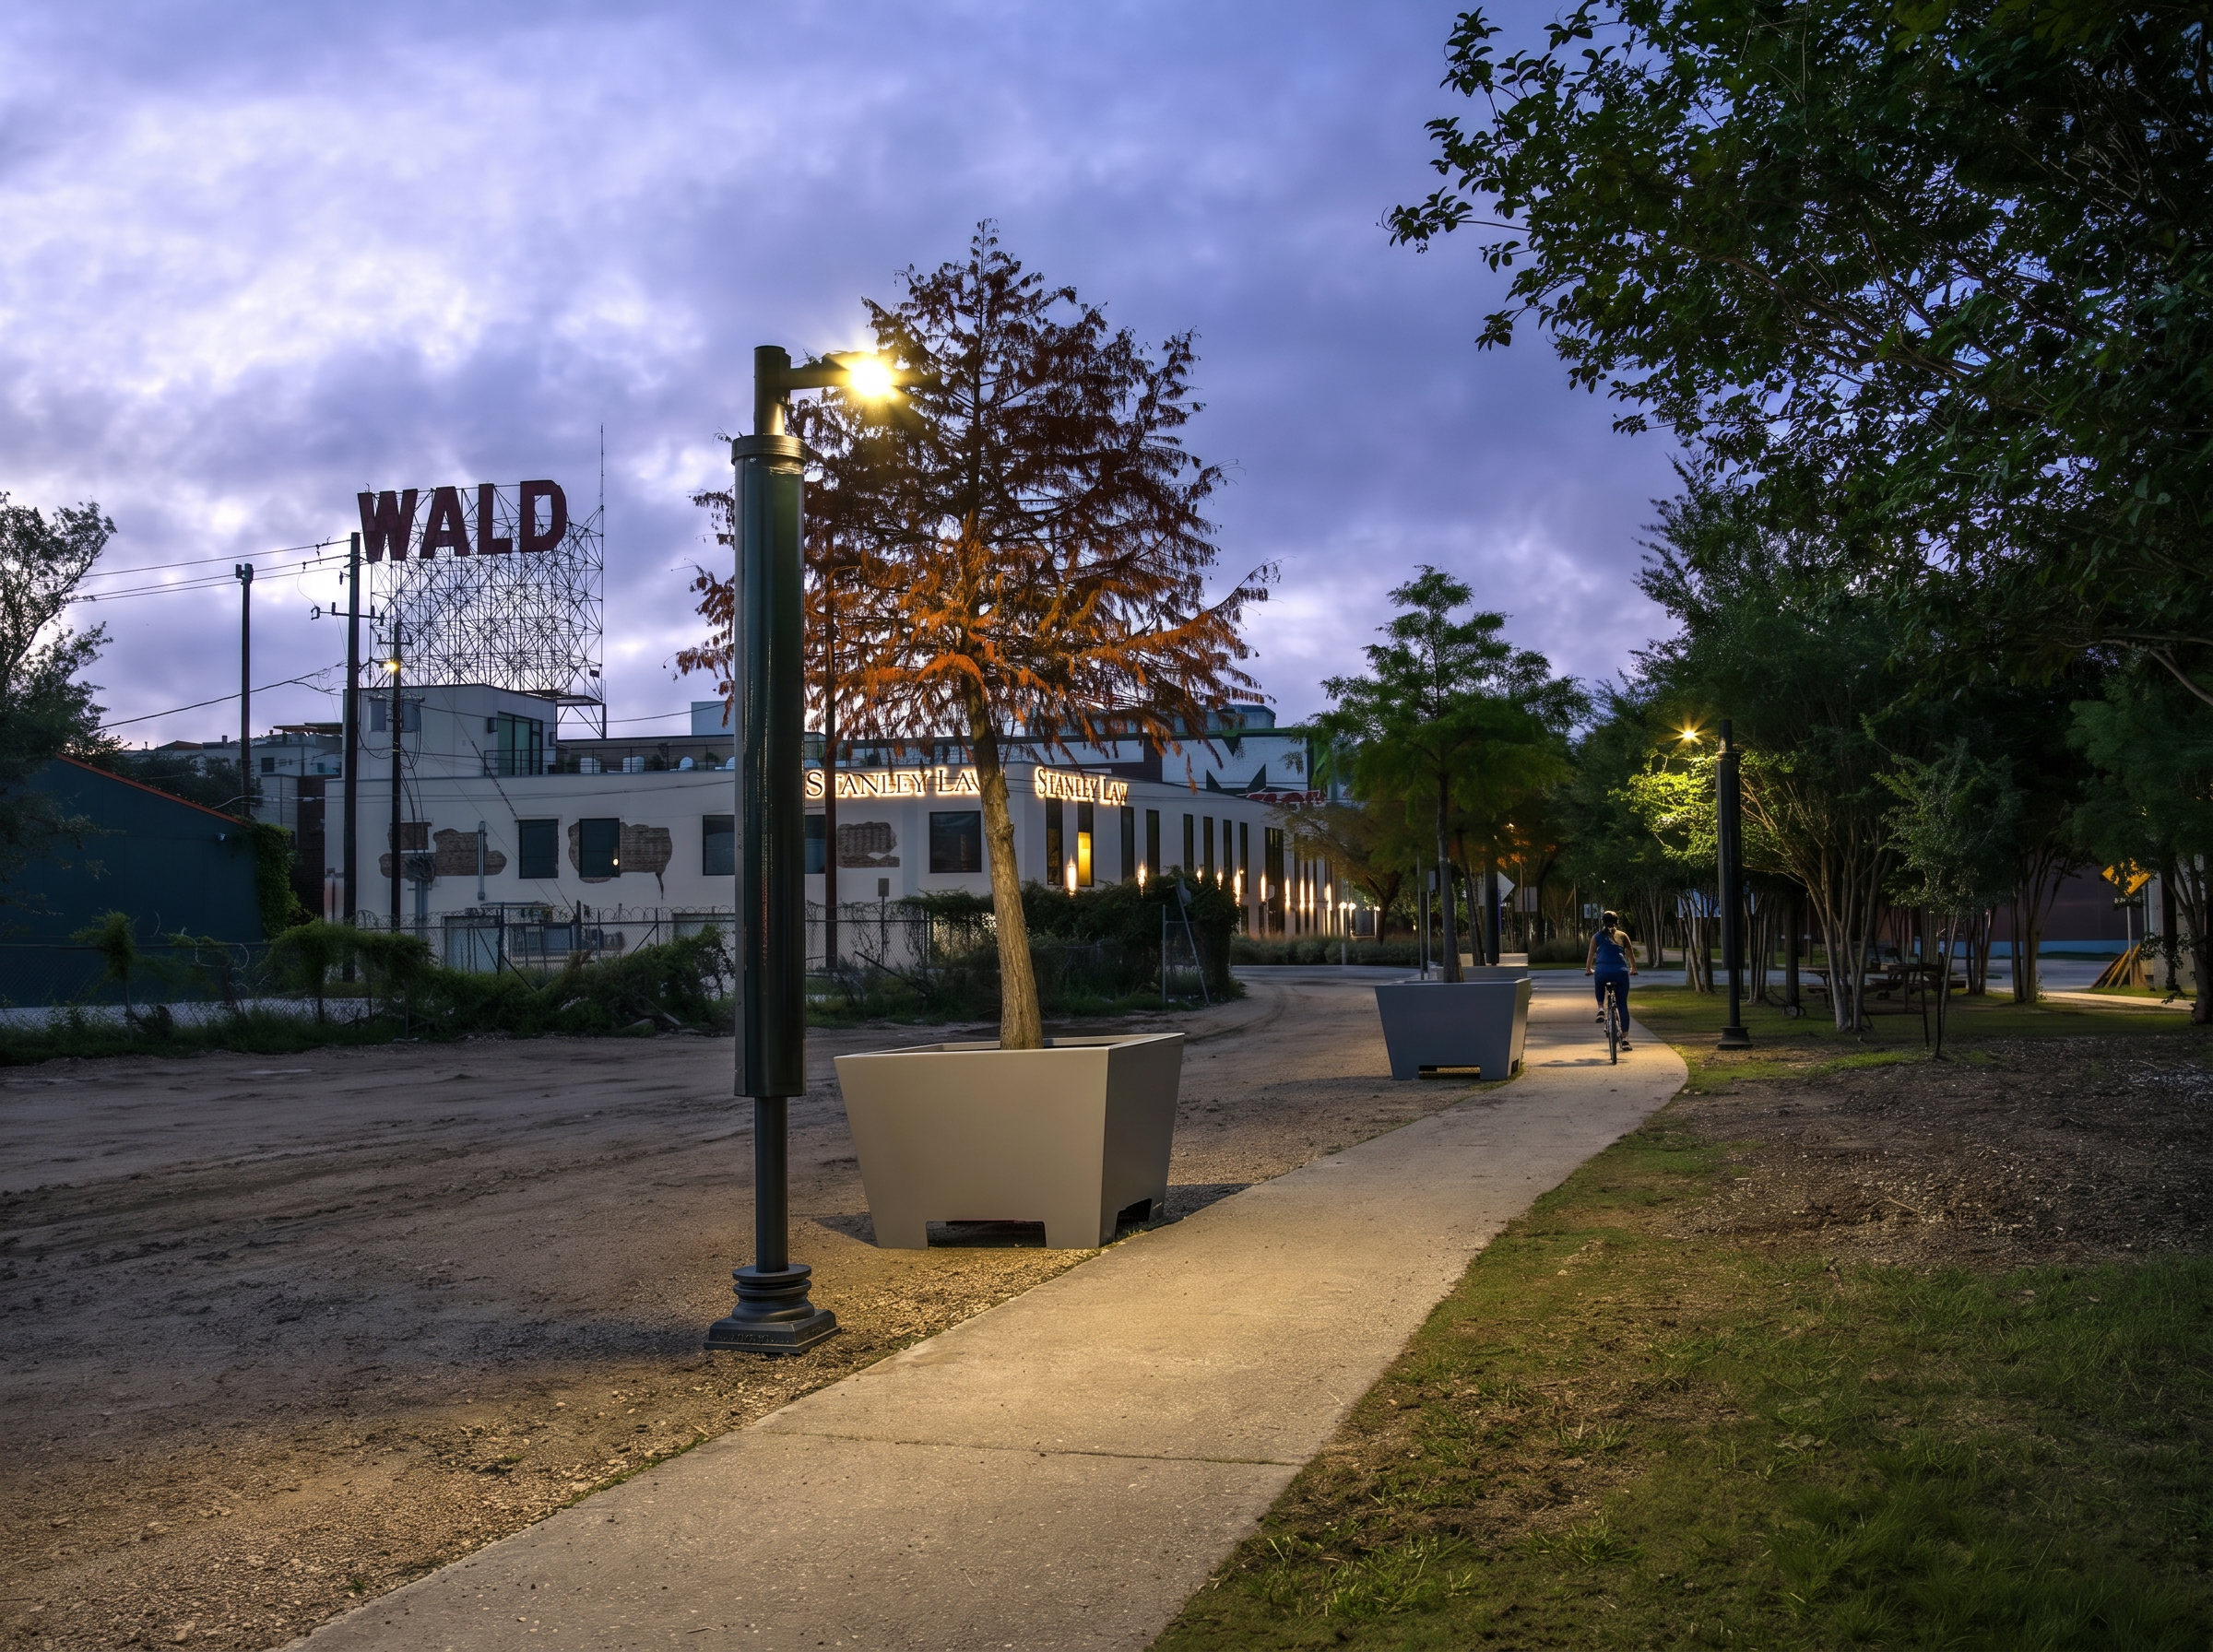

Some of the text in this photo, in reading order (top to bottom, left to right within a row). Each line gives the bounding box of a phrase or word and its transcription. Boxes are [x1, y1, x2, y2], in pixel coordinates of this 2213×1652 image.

[357, 479, 567, 564] WALD
[1036, 767, 1130, 804] STANLEY LAW
